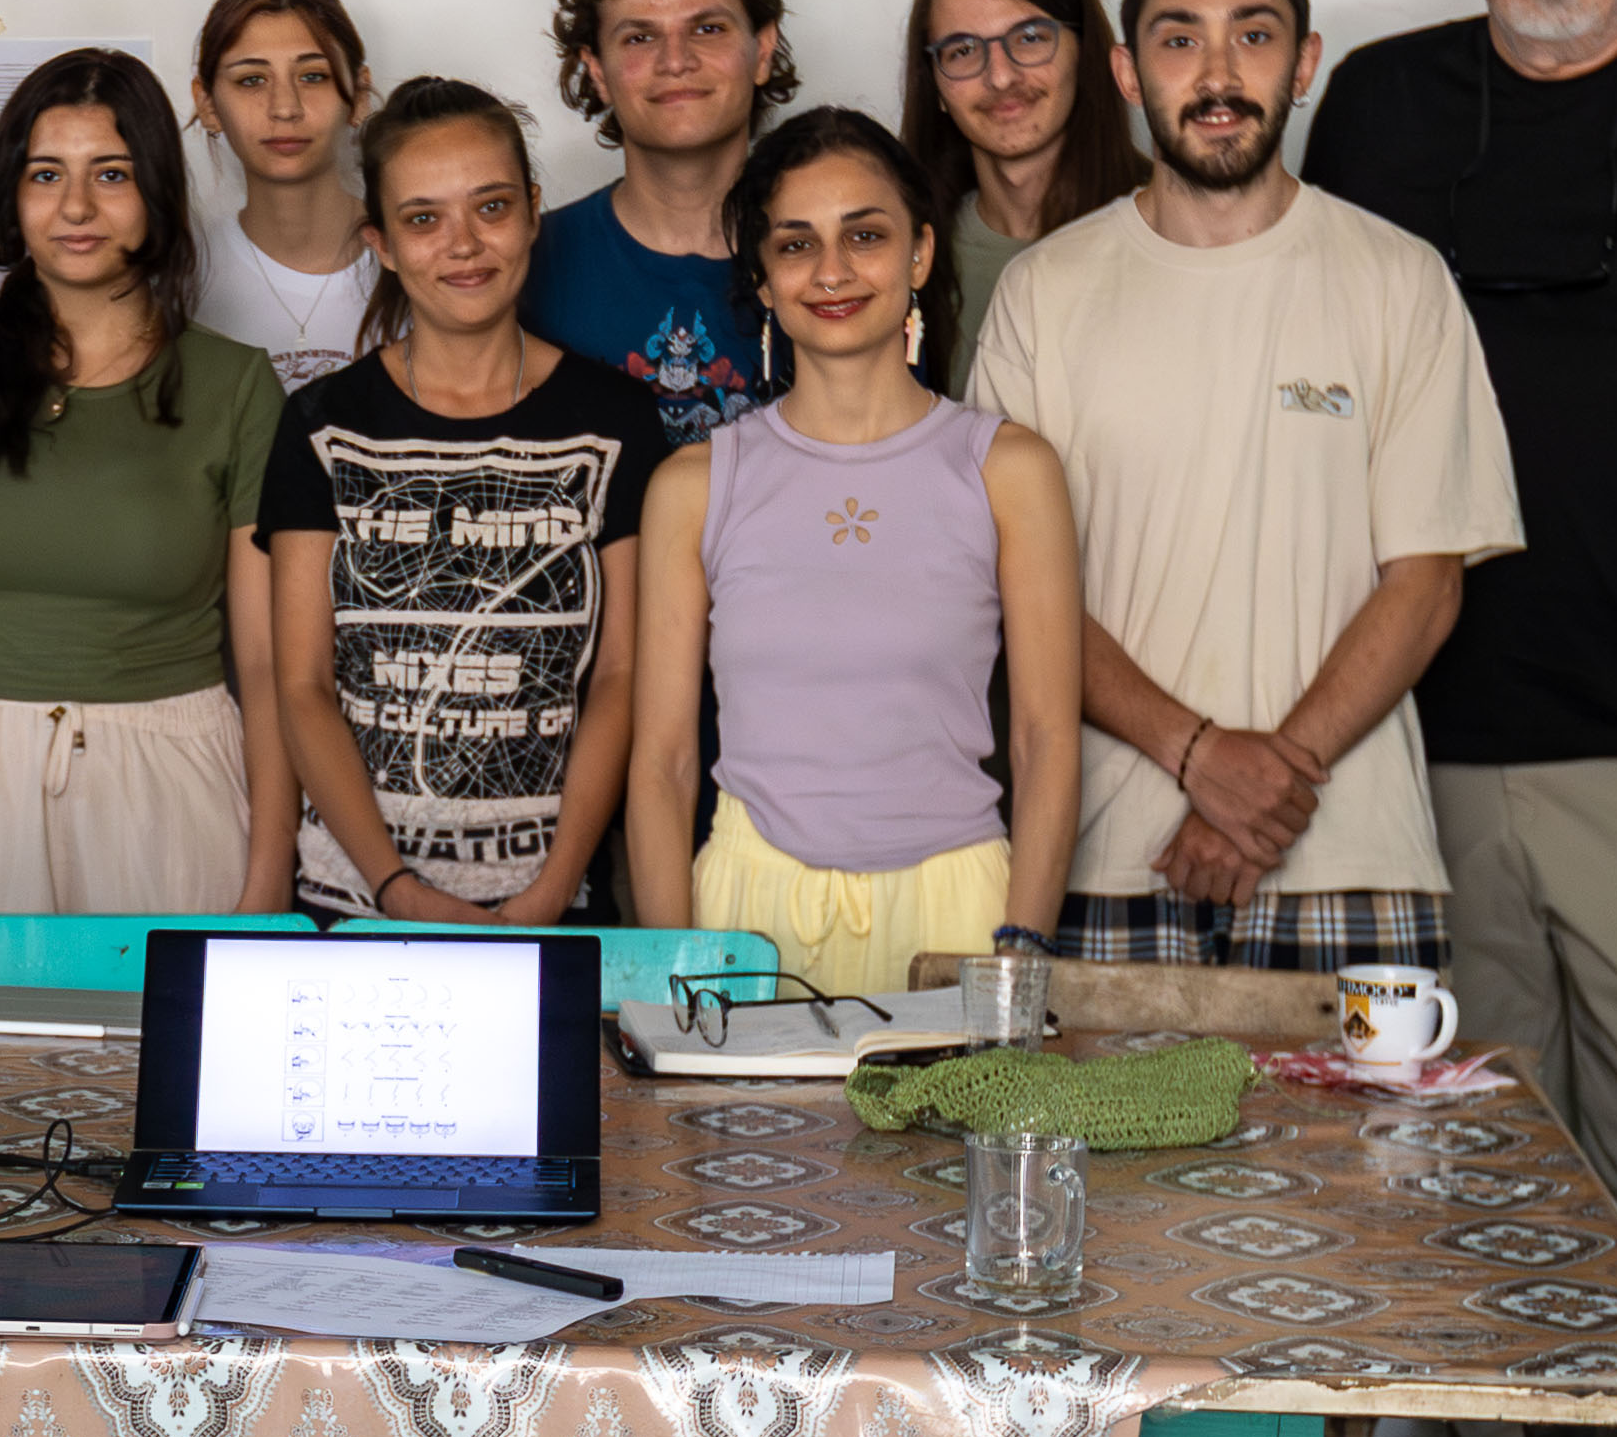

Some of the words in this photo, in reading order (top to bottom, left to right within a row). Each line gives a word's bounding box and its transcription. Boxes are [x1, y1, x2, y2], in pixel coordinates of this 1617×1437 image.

[336, 504, 432, 544] THE
[451, 506, 584, 548] MIND
[373, 650, 523, 696] MIXES
[379, 702, 528, 738] CULTURE
